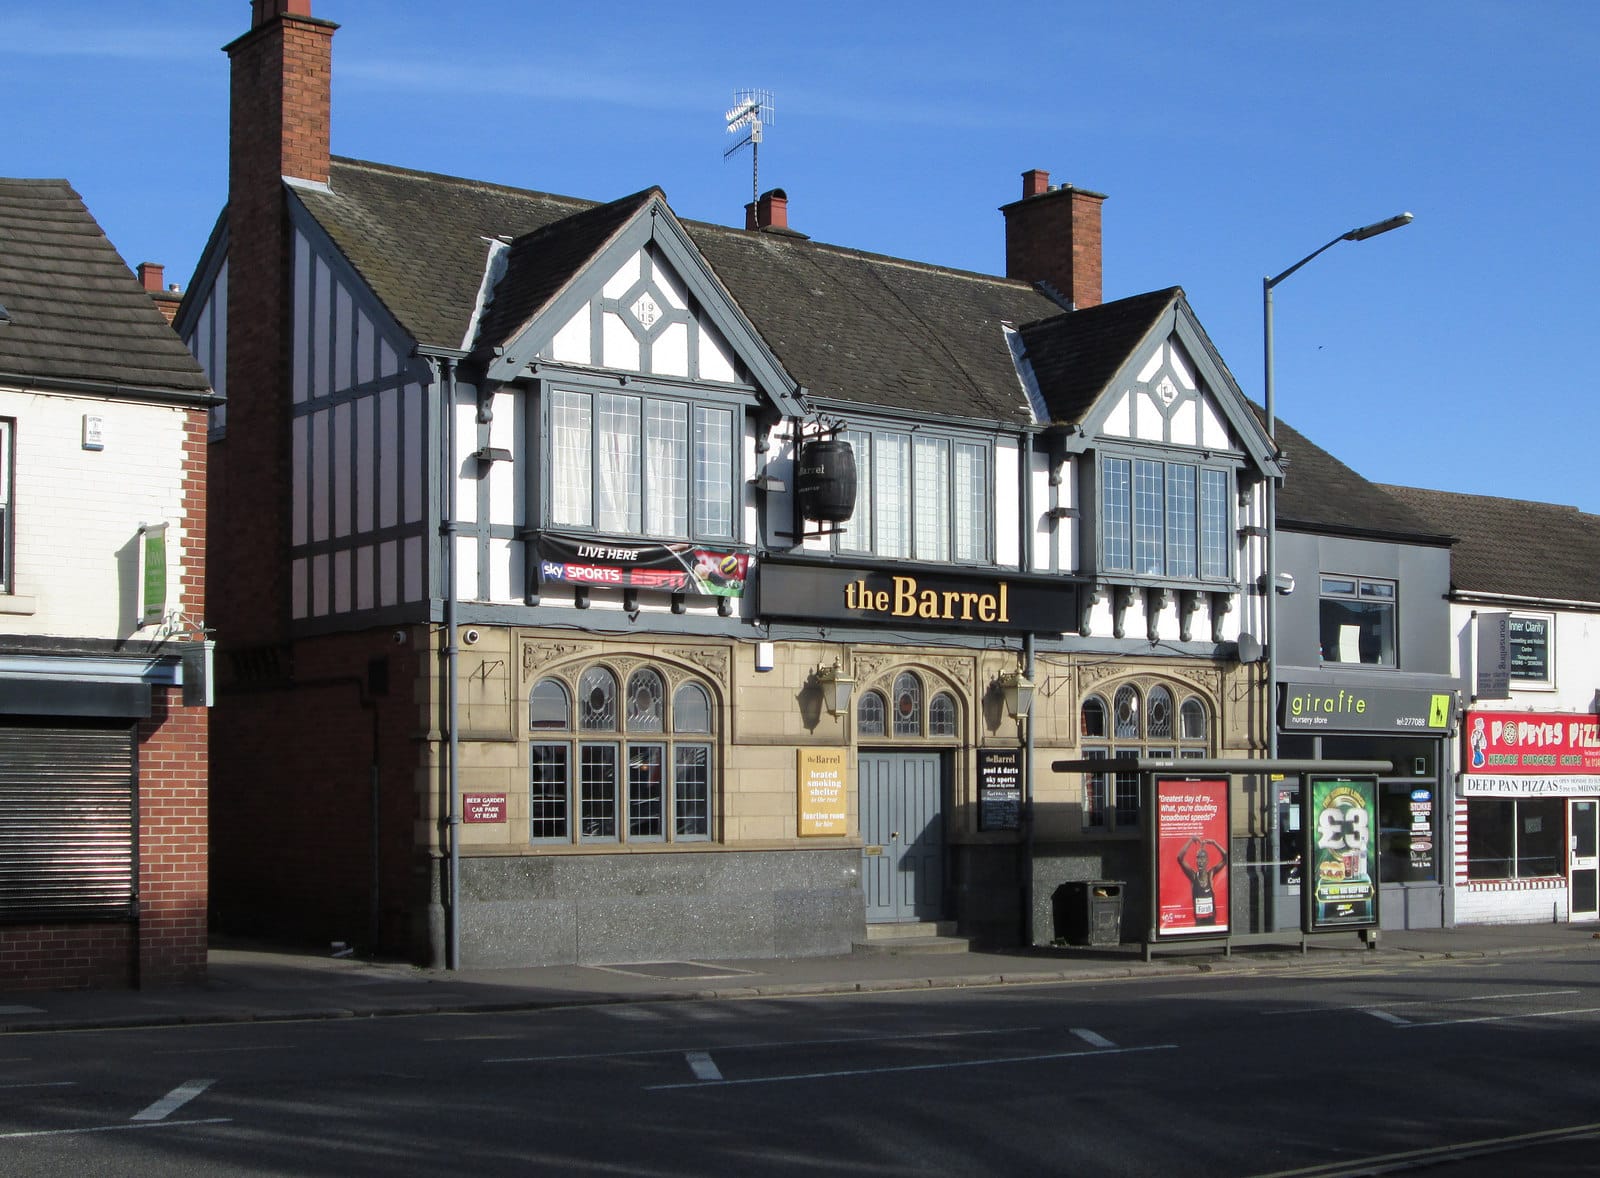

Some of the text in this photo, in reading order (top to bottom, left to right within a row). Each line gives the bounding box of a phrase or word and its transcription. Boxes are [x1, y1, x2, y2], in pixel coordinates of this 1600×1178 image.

[577, 545, 640, 561] LIVE HERE
[543, 563, 564, 578] sky
[566, 566, 620, 581] SPORTS
[845, 576, 1009, 622] the Barrel
[1509, 620, 1545, 635] Inner Clarity
[1291, 690, 1366, 715] giraffe
[1291, 716, 1313, 724] nursery
[816, 755, 840, 764] Barrel
[993, 754, 1016, 764] Barrel
[1488, 754, 1519, 766] KEBABS
[1522, 754, 1557, 766] BURGERS
[1560, 754, 1582, 766] CHIPS
[810, 770, 838, 779] heated
[986, 776, 1016, 784] sky sports
[807, 779, 842, 788] smoking
[1467, 778, 1558, 792] DEEP PAN PIZZAS
[810, 788, 838, 796] shelter
